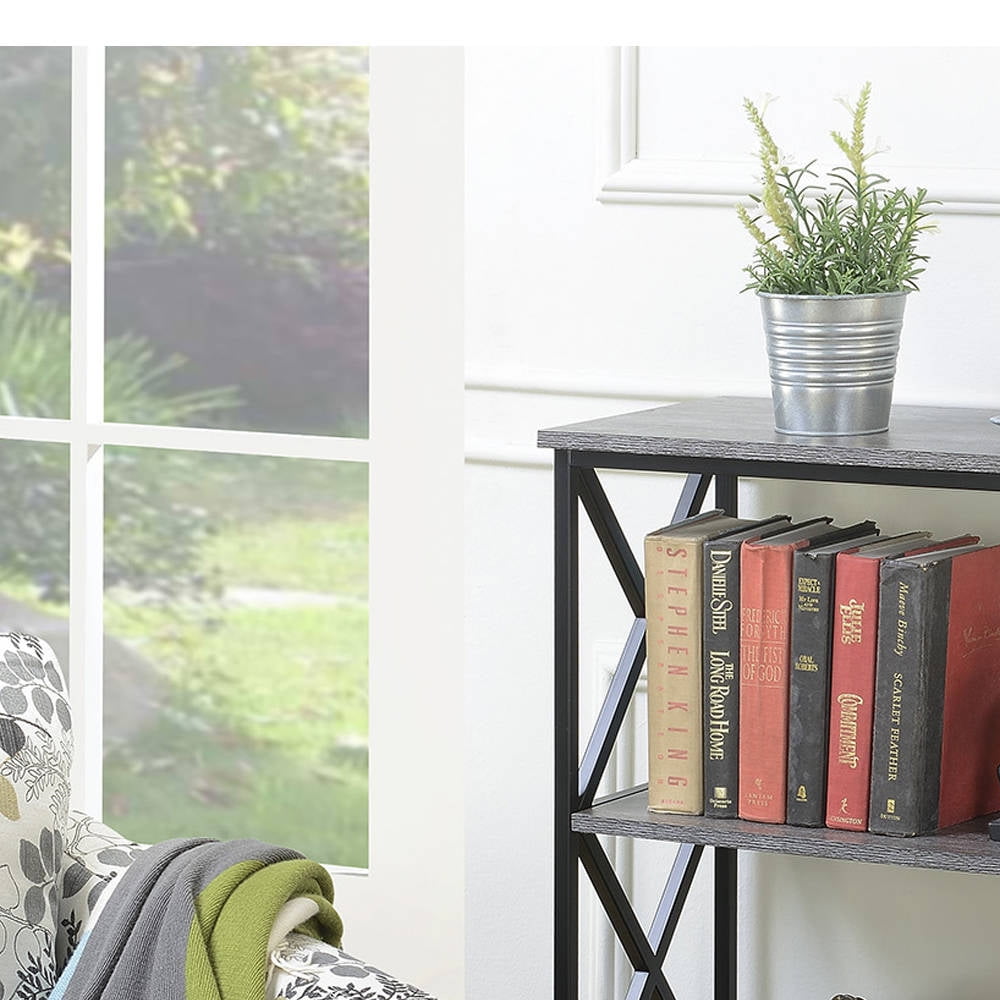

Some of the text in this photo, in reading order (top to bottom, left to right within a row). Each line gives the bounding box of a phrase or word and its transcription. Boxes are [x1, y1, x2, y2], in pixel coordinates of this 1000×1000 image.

[710, 550, 733, 635] DANIELLE STEEL
[893, 581, 909, 657] Maeve Binchy
[666, 547, 689, 787] STEPHEN KING
[724, 663, 735, 680] THE
[741, 645, 784, 664] THE FIST
[743, 662, 782, 682] OF GOD
[708, 651, 731, 761] LONG ROAD HOME
[837, 693, 863, 769] COMMITMENT
[887, 672, 903, 781] SCARLET FEATHER
